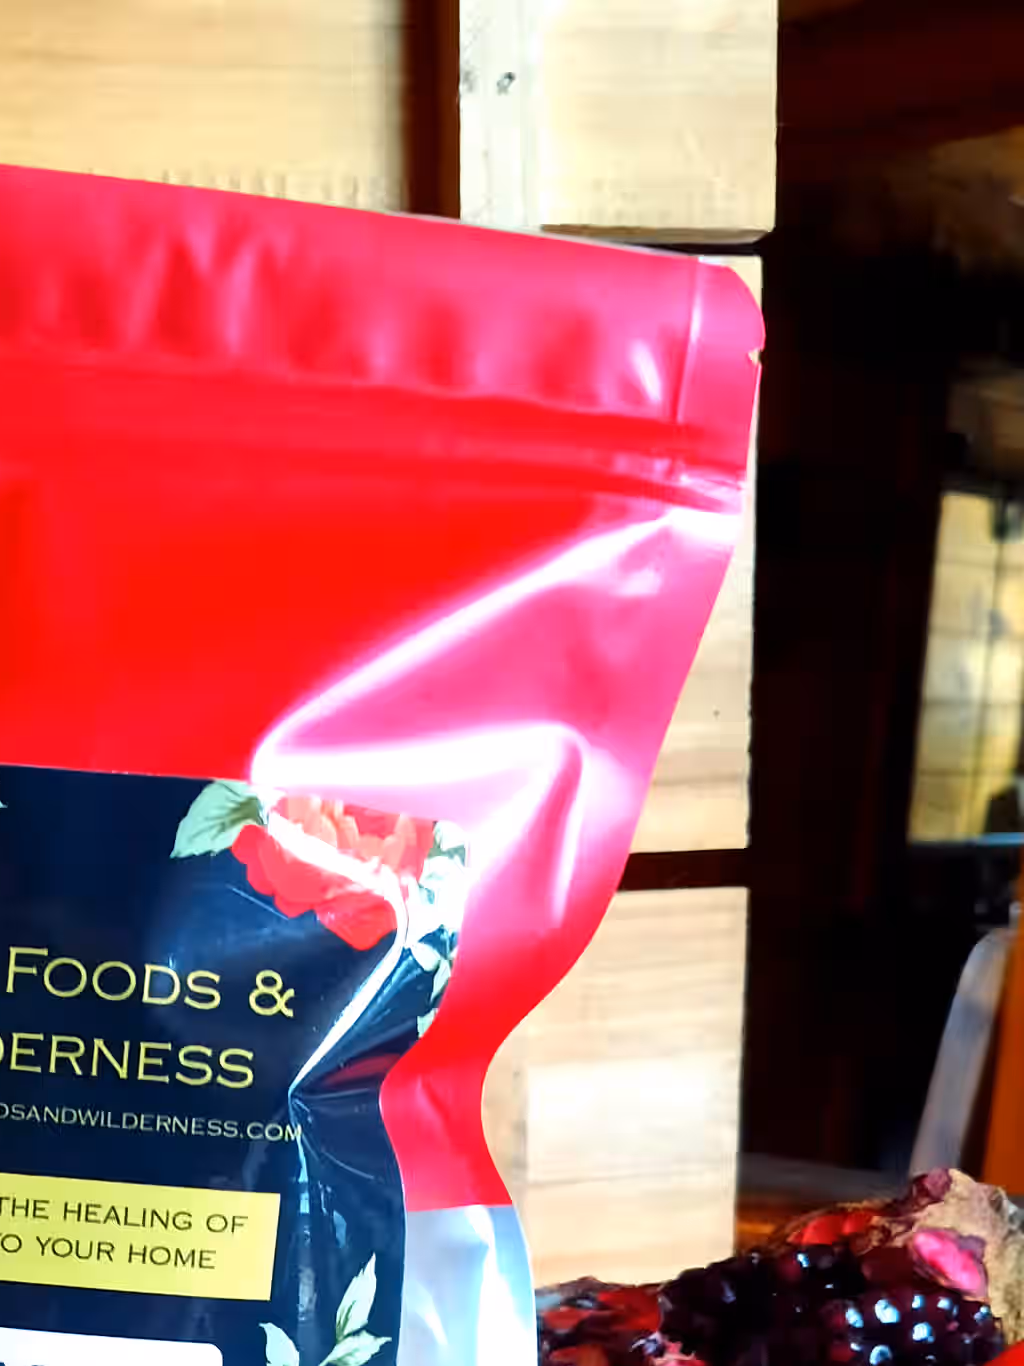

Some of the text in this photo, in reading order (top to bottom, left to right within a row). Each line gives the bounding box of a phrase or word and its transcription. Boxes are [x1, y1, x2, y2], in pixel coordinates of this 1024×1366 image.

[248, 969, 295, 1018] &
[63, 1201, 193, 1233] HEALING
[206, 1213, 249, 1235] OF
[35, 1235, 115, 1262] YOUR
[127, 1243, 217, 1271] HOME
